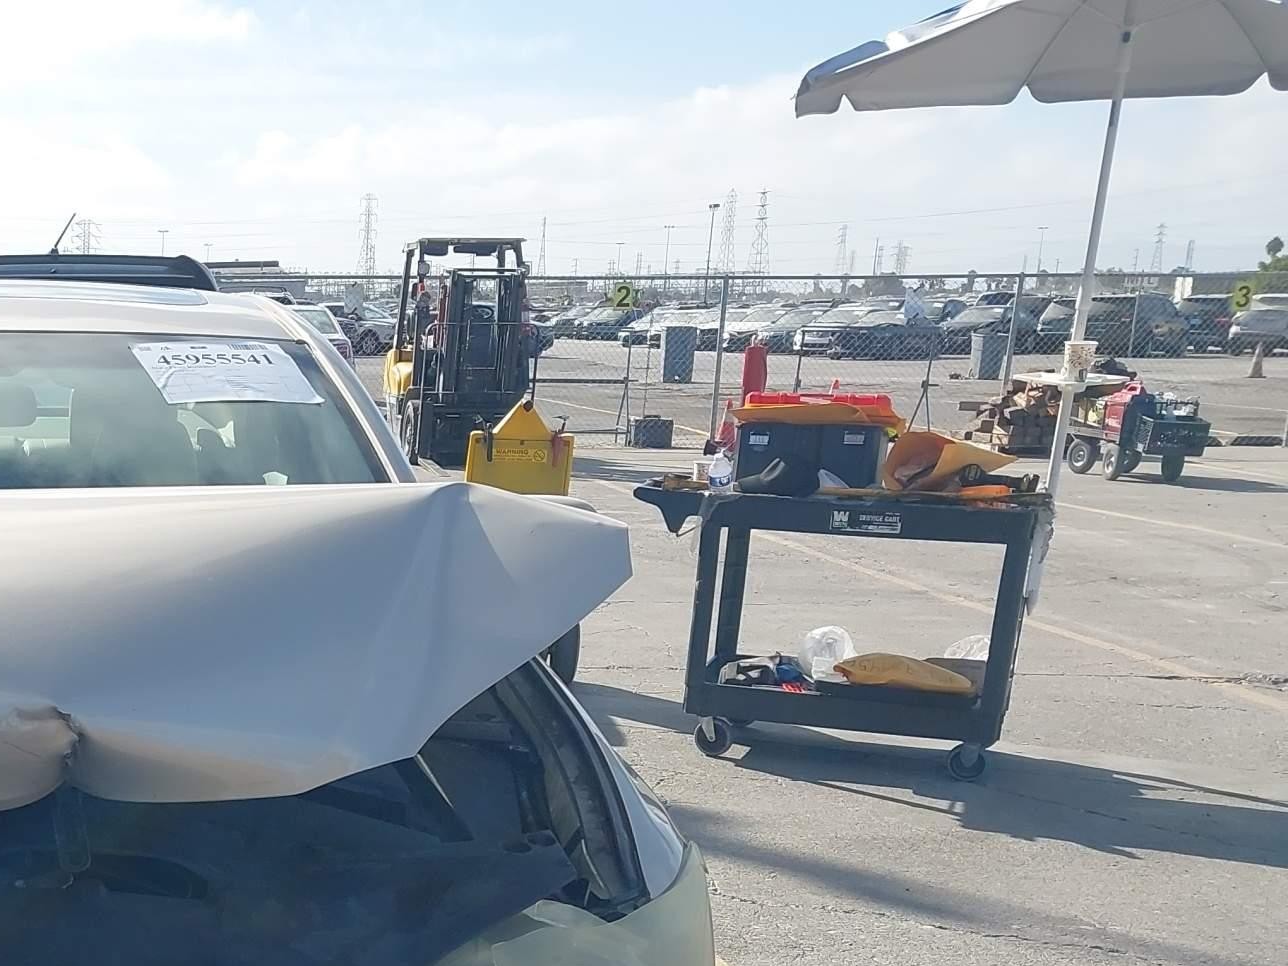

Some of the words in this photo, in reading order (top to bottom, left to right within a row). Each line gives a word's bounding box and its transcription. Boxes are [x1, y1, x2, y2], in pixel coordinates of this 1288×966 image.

[616, 285, 631, 307] 2
[1236, 285, 1251, 307] 3
[157, 353, 275, 366] 45955541
